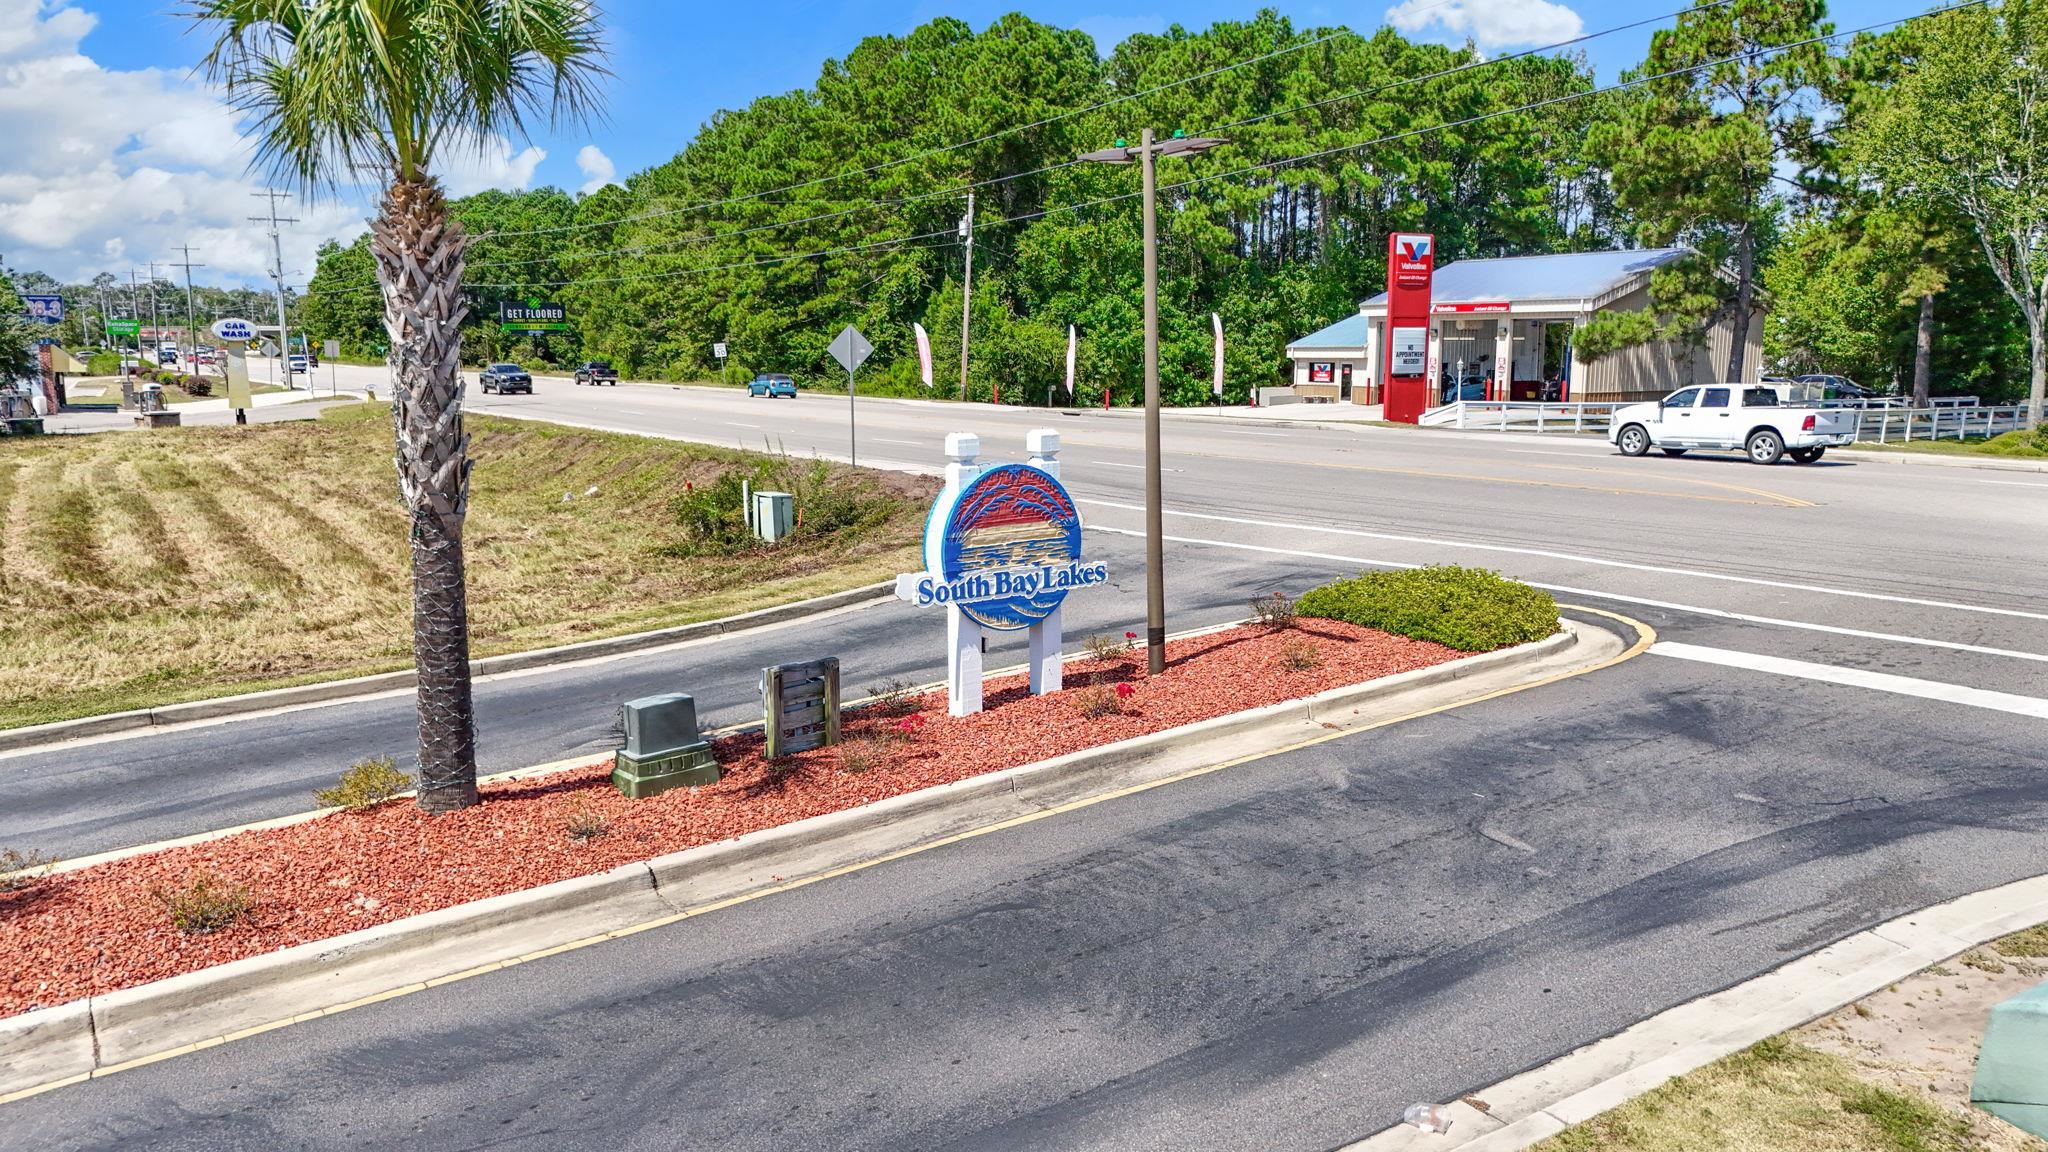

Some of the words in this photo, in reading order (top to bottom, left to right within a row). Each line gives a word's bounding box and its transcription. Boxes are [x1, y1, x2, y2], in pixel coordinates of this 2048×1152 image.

[1401, 262, 1427, 270] Valvoline
[507, 309, 522, 319] GET
[526, 309, 563, 319] FLOORED
[918, 574, 990, 605] South
[993, 571, 1039, 599] Bay
[1042, 563, 1106, 588] Lakes
